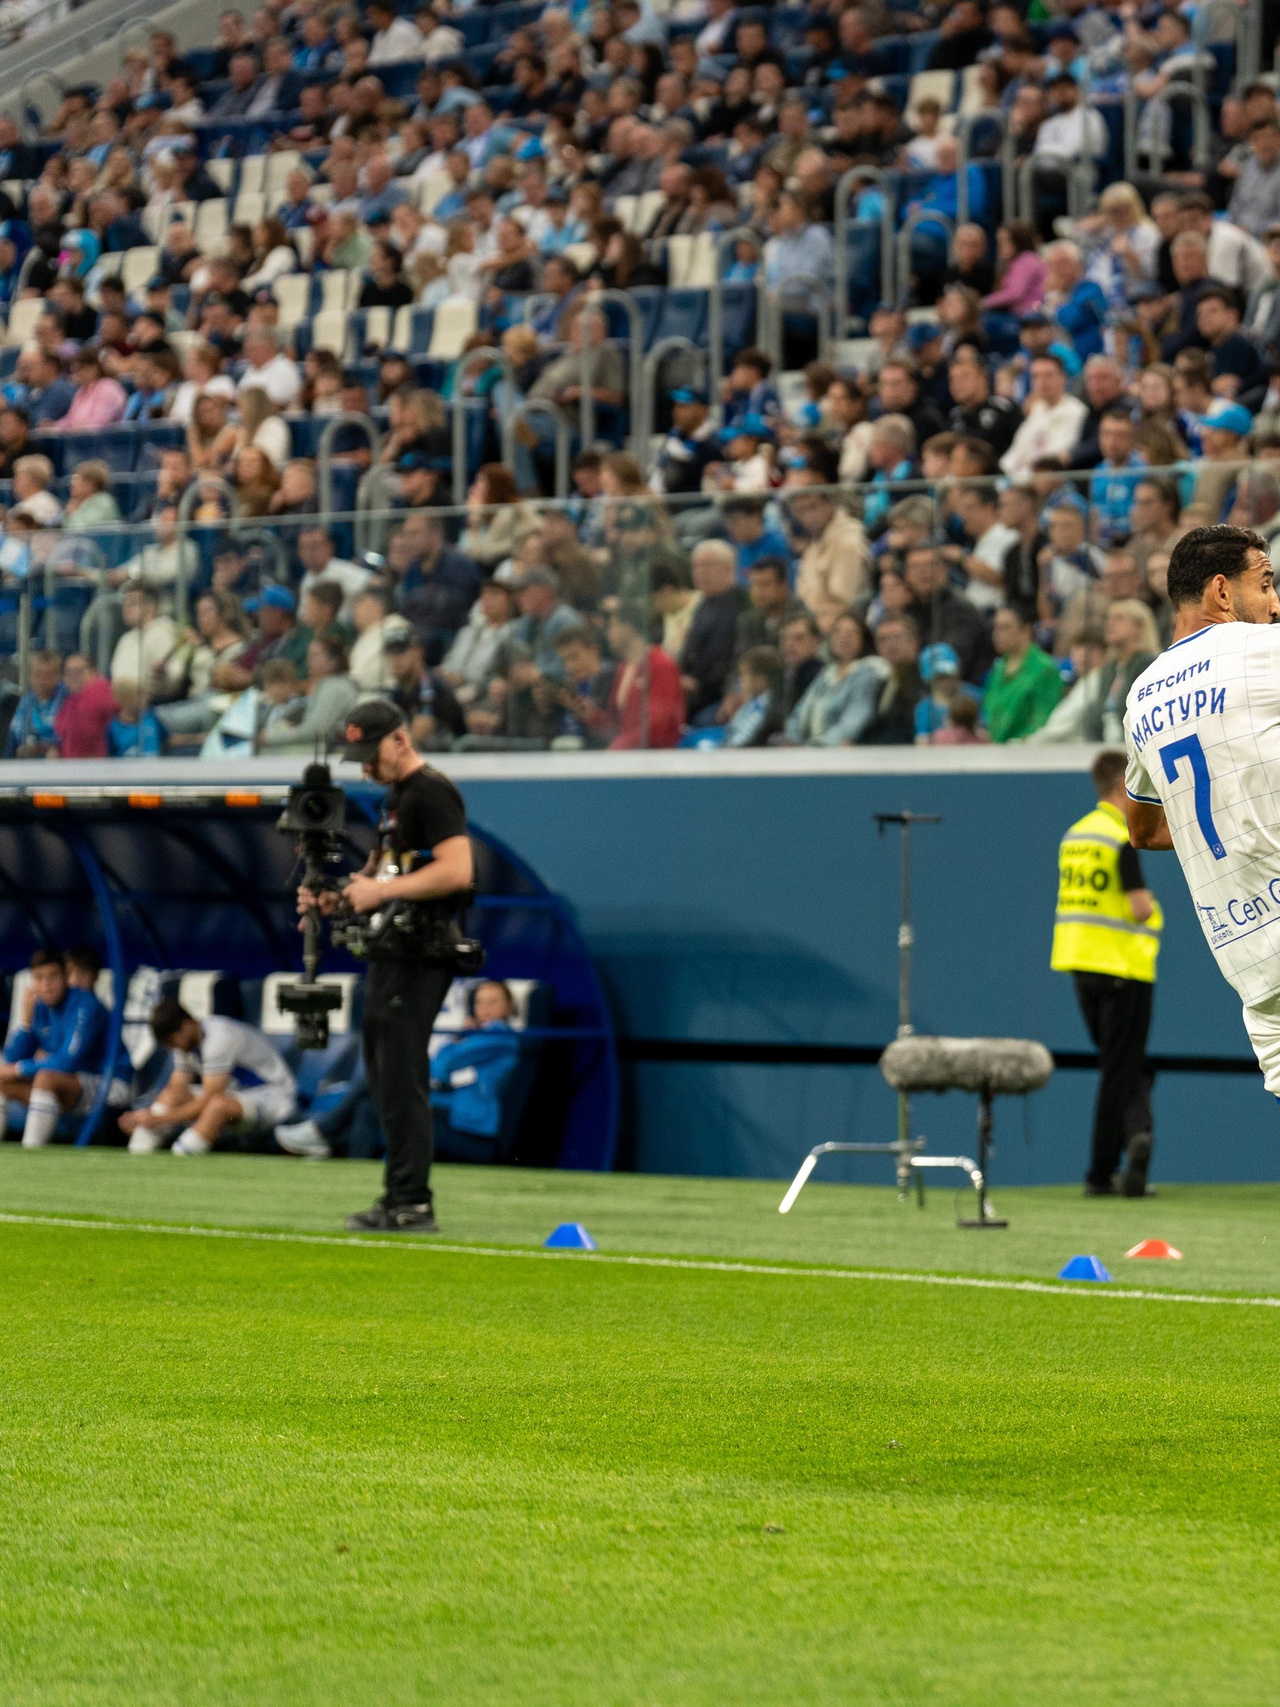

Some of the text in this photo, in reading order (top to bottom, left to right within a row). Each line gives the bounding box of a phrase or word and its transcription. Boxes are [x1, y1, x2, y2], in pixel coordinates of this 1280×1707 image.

[1137, 659, 1211, 702] БЕТСИТИ
[1131, 687, 1226, 753] МАСТУРИ
[1158, 733, 1227, 861] 7
[1227, 898, 1271, 926] Cen
